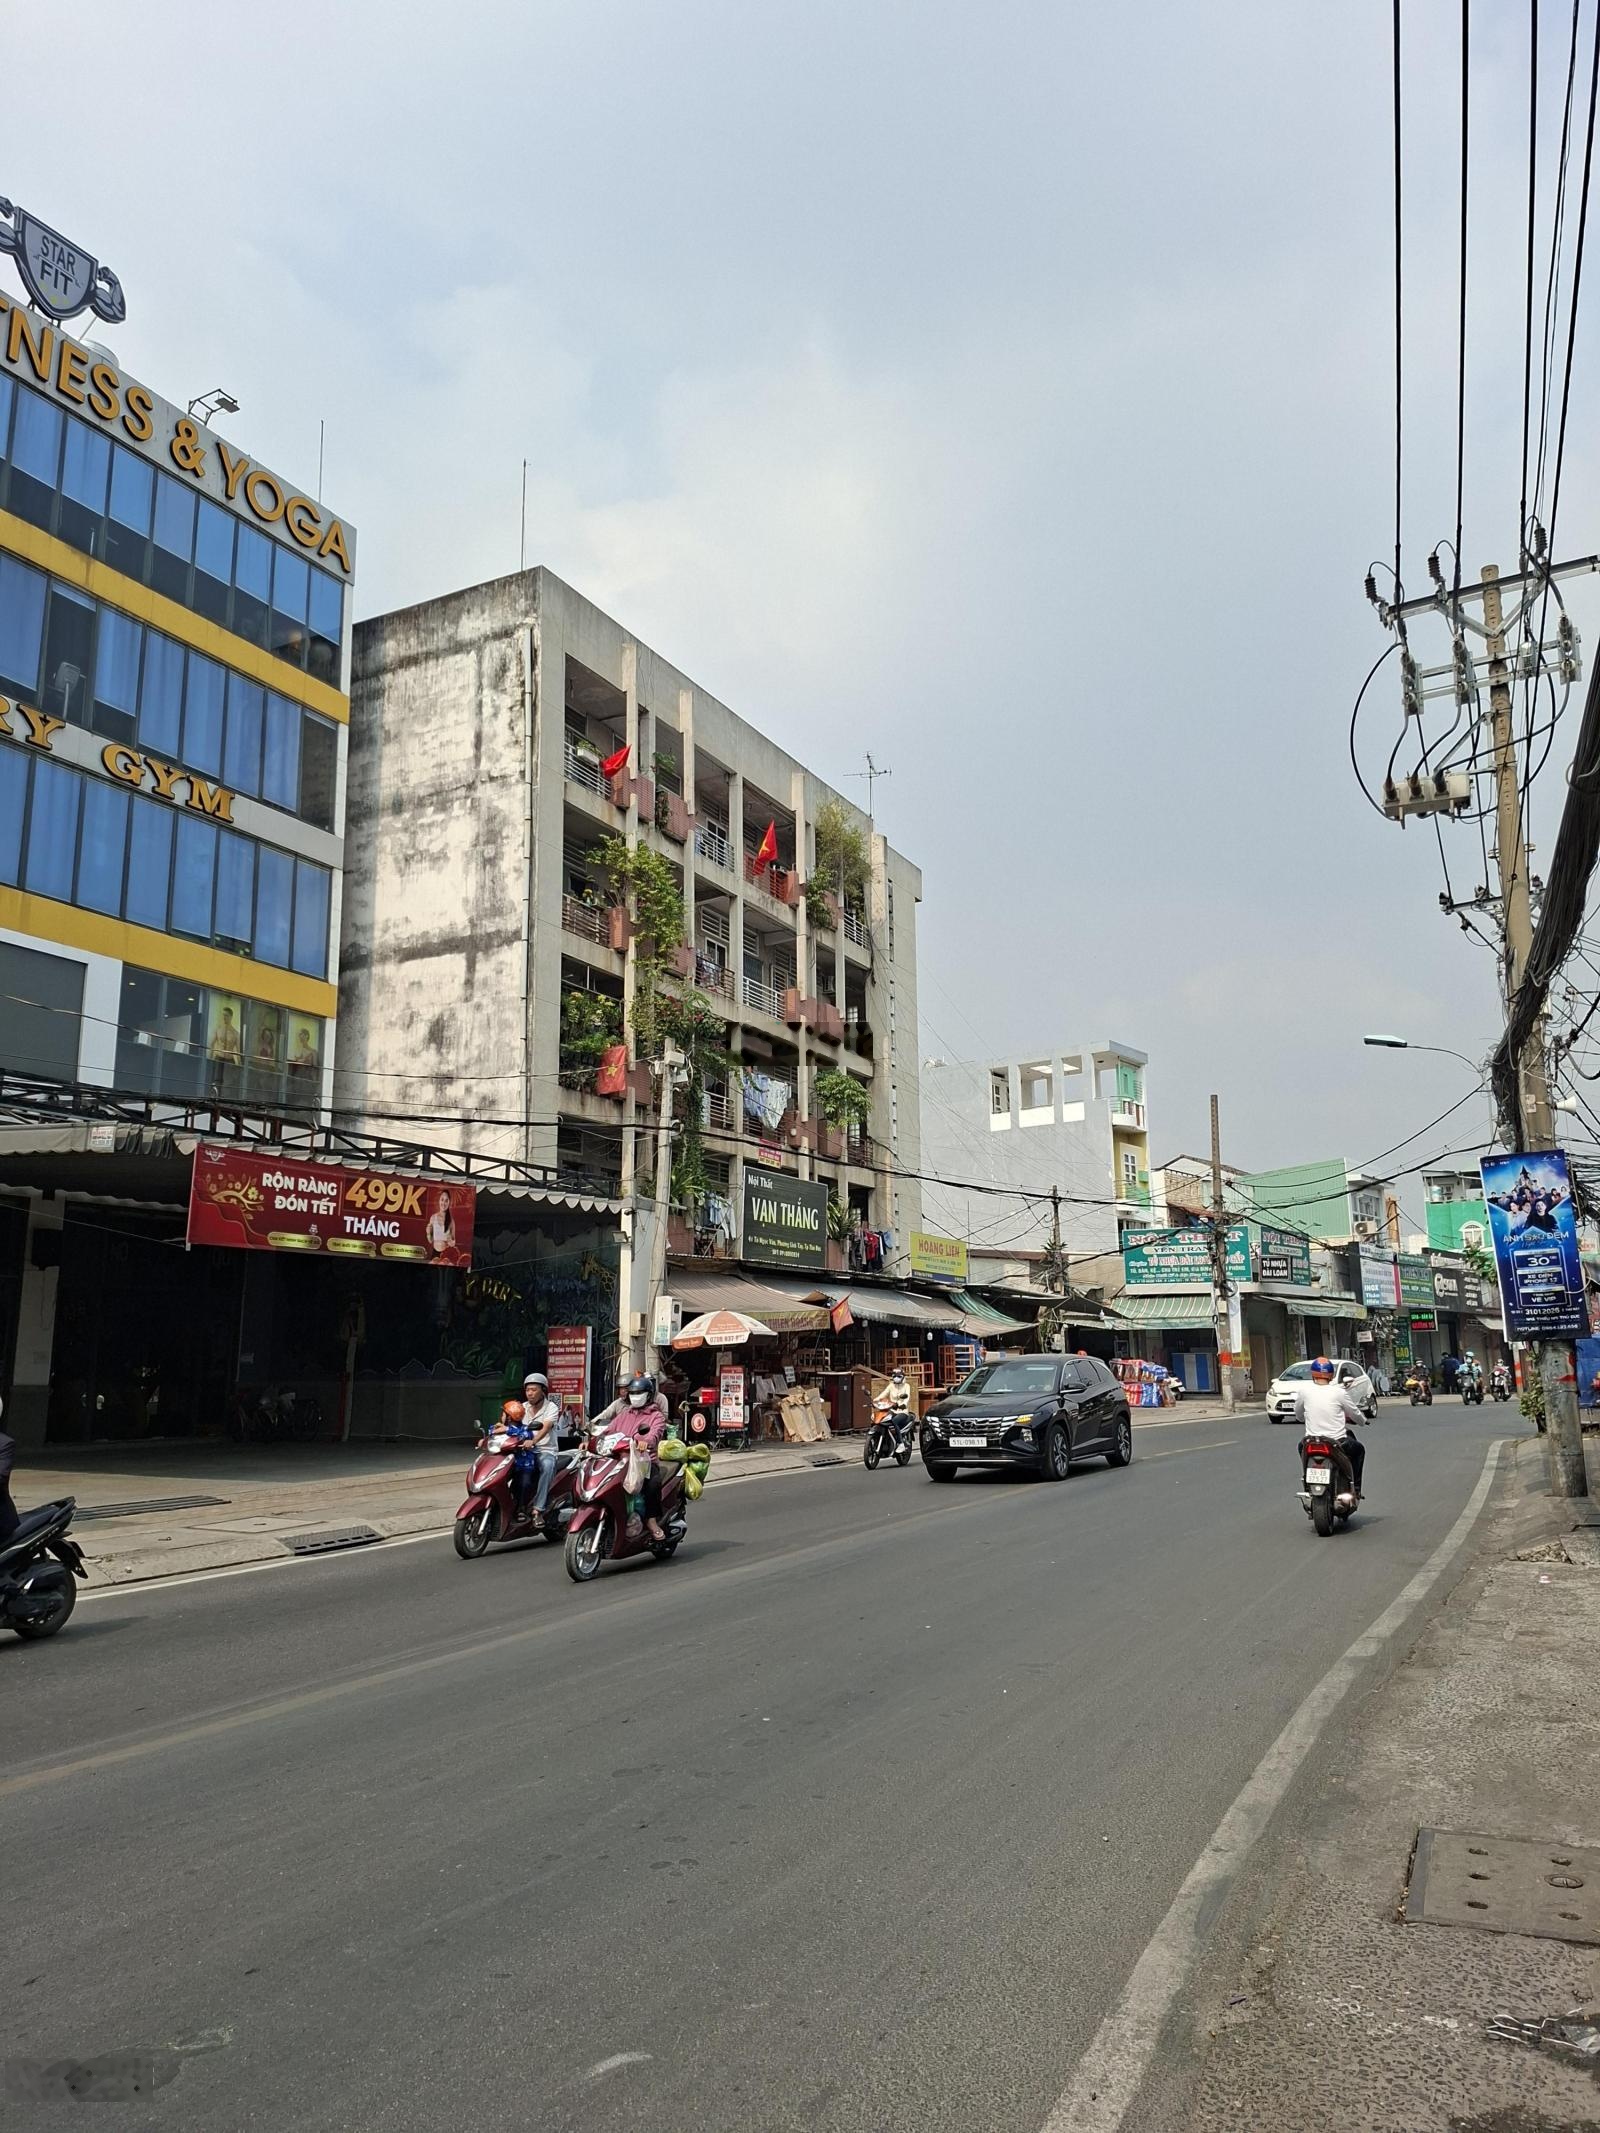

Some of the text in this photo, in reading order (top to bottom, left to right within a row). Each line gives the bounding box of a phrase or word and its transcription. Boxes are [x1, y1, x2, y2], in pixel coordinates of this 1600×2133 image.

[40, 234, 77, 274] STAR
[39, 263, 74, 298] FIT
[170, 419, 206, 479] &
[216, 440, 351, 573] YOGA
[101, 741, 237, 824] GYM
[262, 1171, 338, 1196] RỘN RÀNG
[345, 1177, 427, 1217] 499K
[274, 1194, 337, 1216] ĐÓN TẾT
[752, 1197, 819, 1231] VẠN THẮNG
[343, 1211, 400, 1238] THÁNG
[1527, 1256, 1550, 1267] 30
